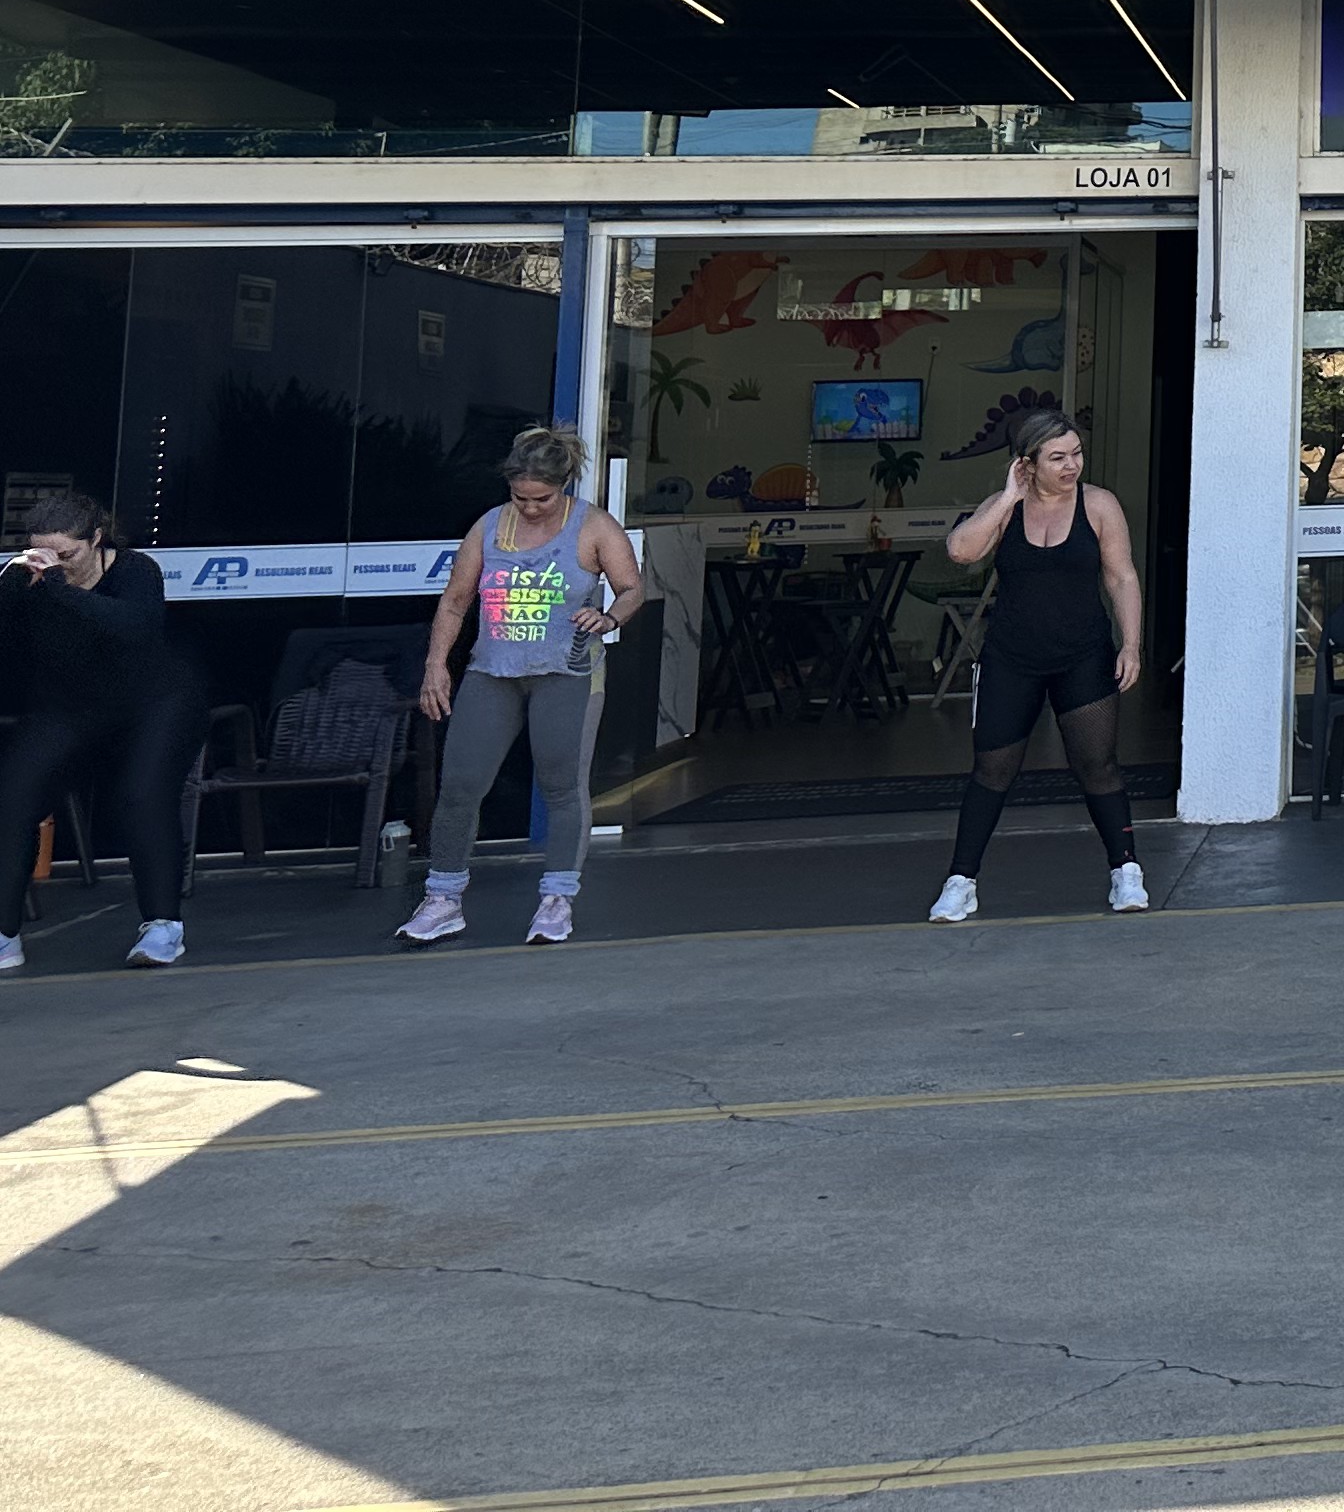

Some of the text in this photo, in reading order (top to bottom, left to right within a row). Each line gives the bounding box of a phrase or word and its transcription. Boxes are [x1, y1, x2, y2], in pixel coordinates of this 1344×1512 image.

[1075, 167, 1171, 188] LOJA 01
[1302, 526, 1342, 536] PESSOAS
[353, 562, 417, 574] PESSOAS REAIS
[426, 550, 455, 578] A
[254, 565, 333, 577] RESULTADOS REAIS
